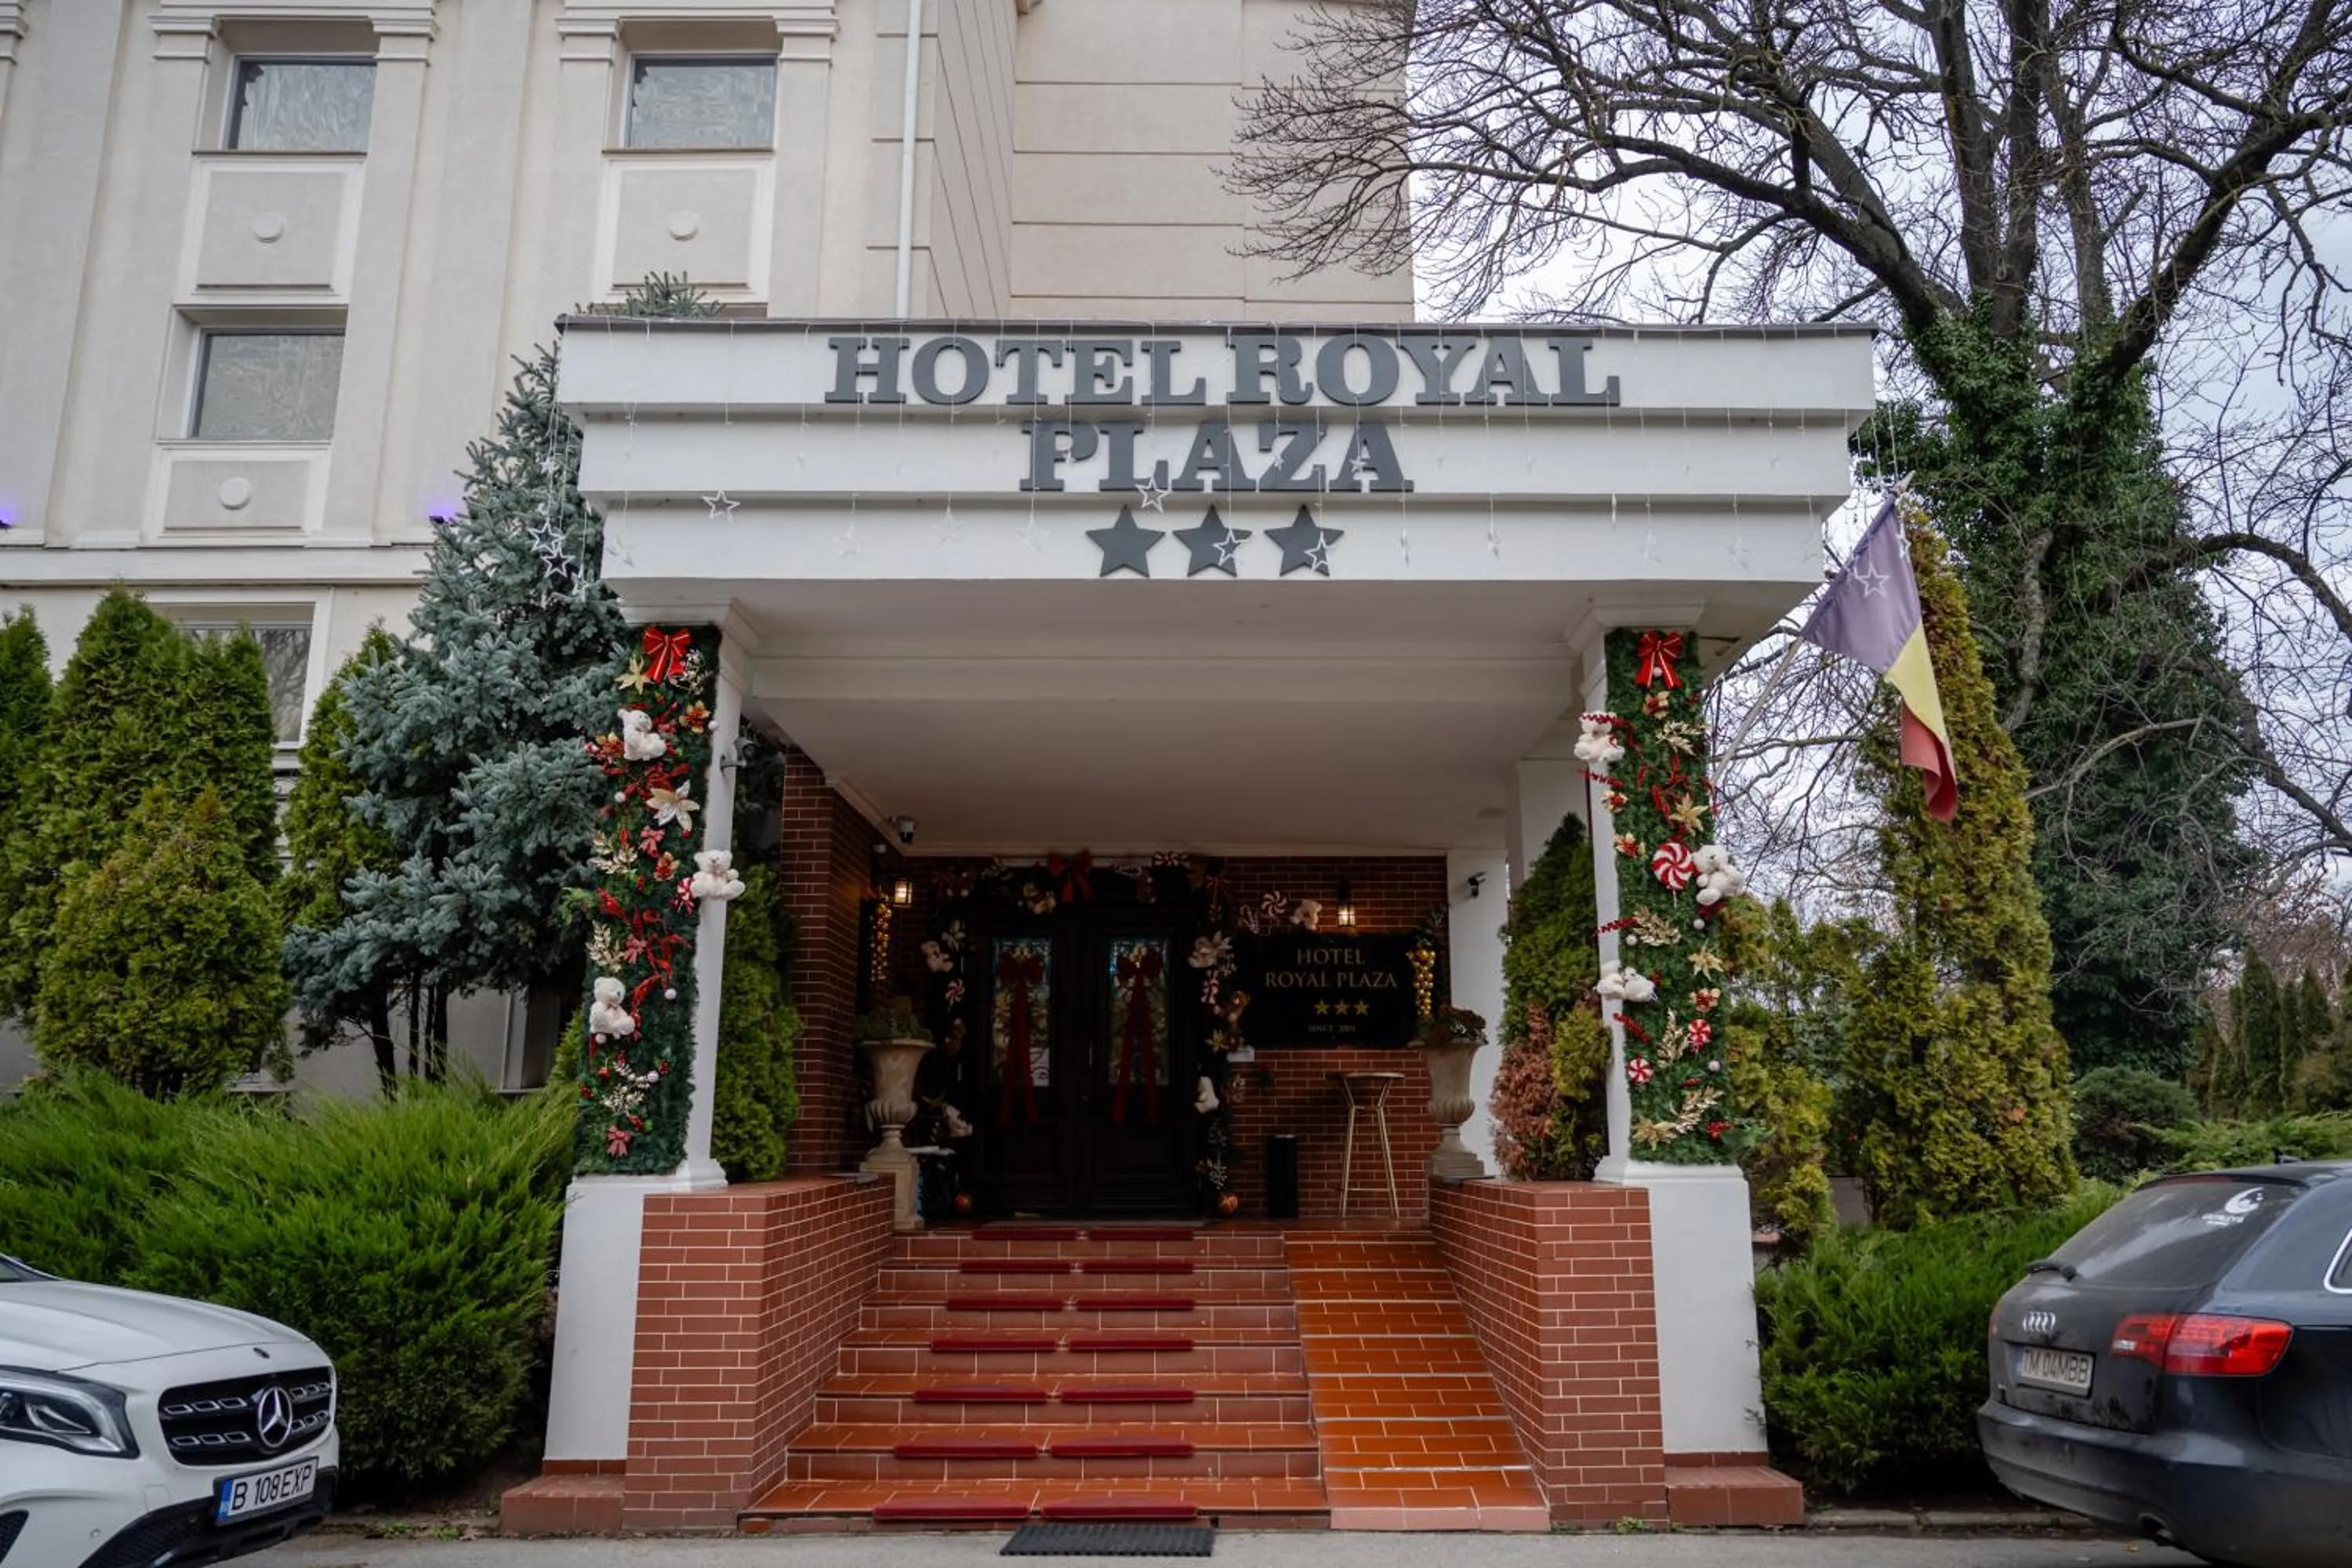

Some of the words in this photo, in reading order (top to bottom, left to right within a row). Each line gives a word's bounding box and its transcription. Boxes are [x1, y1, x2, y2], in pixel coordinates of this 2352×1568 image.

[824, 336, 1207, 407] HOTEL
[1226, 333, 1621, 407] ROYAL
[1020, 419, 1413, 492] PLAZA
[1265, 971, 1331, 988] ROYAL
[1338, 971, 1398, 988] PLAZA
[1297, 948, 1366, 965] HOTEL
[231, 1482, 248, 1511] B
[254, 1465, 313, 1505] 108EXP
